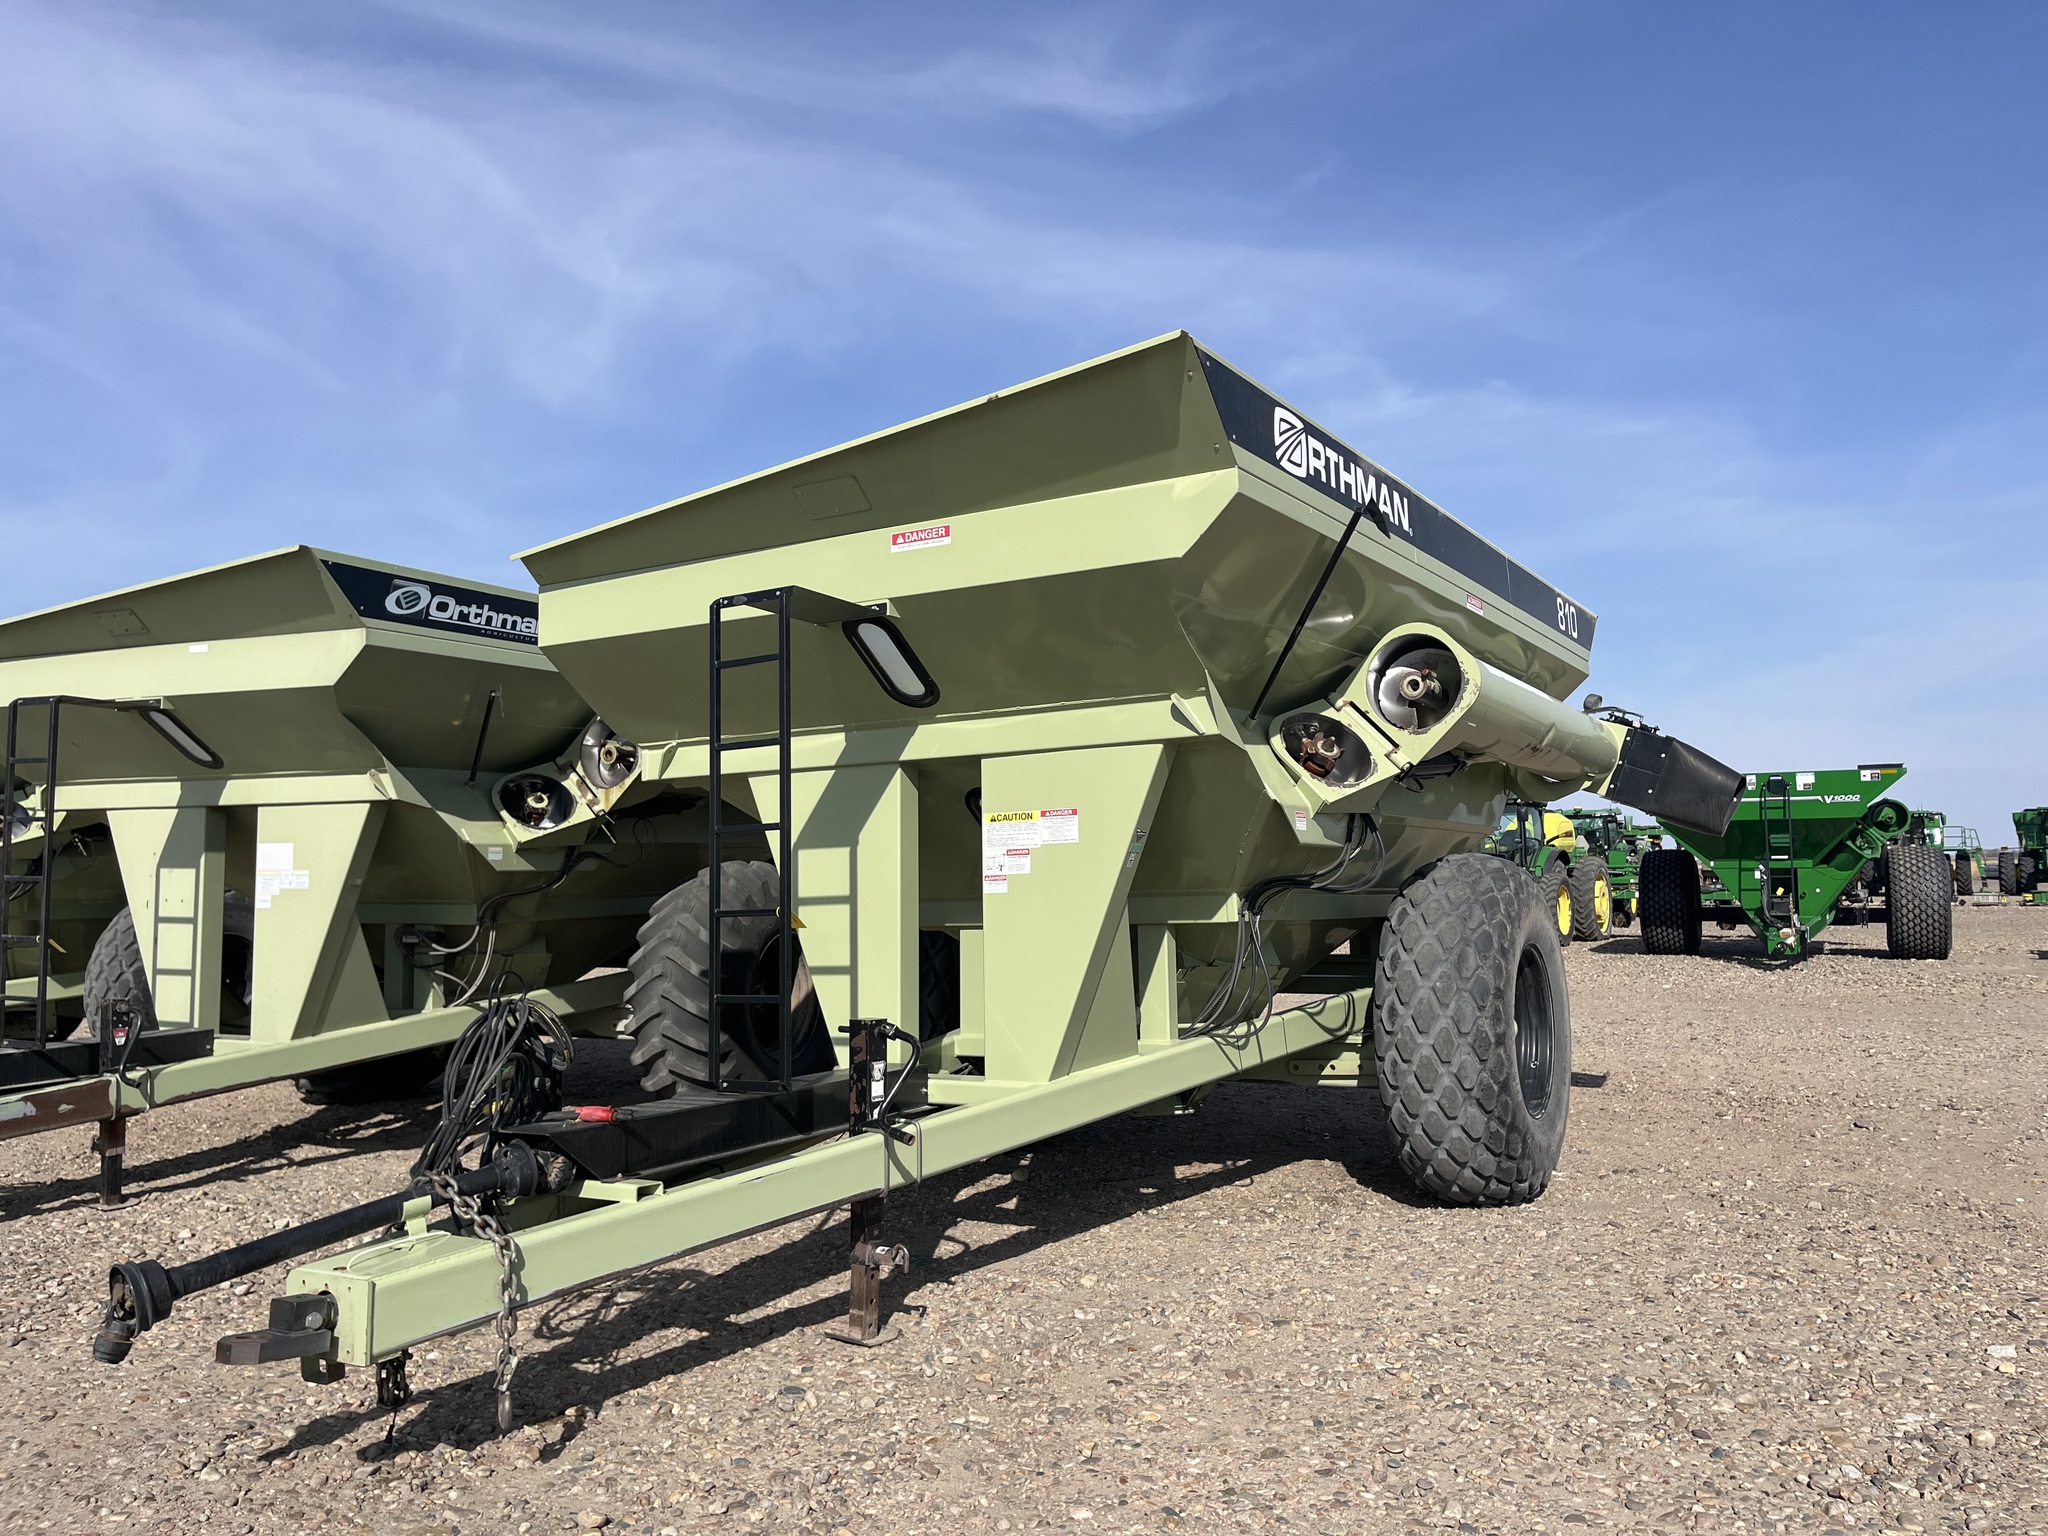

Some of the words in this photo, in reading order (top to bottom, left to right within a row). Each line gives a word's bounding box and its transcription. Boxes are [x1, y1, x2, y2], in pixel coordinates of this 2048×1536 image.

[905, 527, 946, 542] DANGER
[429, 595, 538, 634] Orthma
[1556, 597, 1578, 639] 810
[480, 629, 538, 642] AGRICULTUR
[1824, 794, 1861, 803] V1000
[996, 812, 1033, 822] CAUTION
[1050, 809, 1073, 817] DANGER
